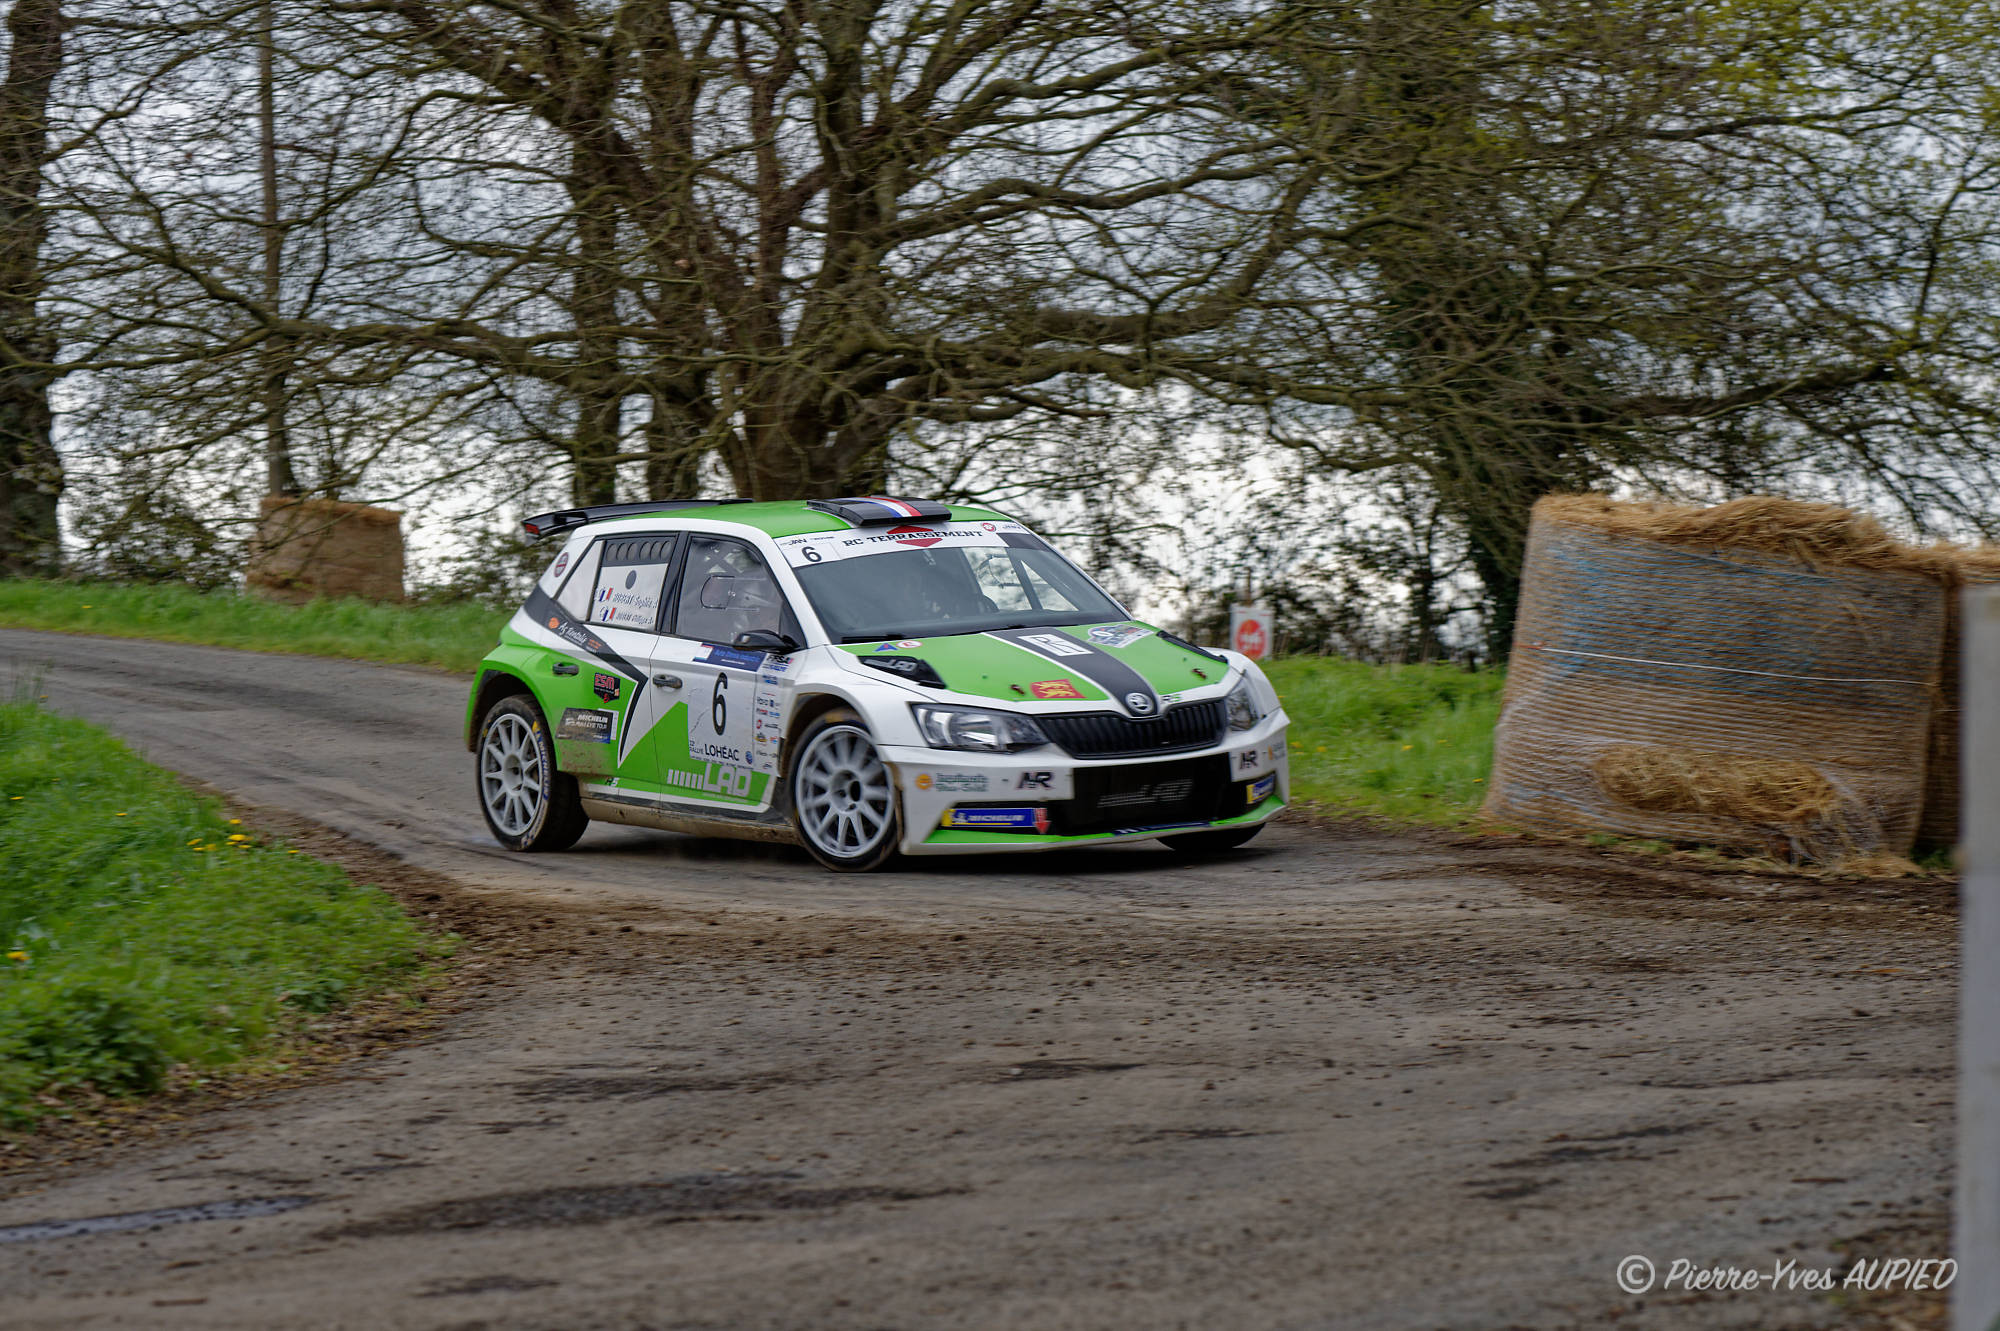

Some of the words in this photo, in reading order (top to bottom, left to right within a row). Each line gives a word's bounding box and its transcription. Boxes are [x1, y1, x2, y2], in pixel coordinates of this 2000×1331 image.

[842, 538, 864, 546] RC
[866, 530, 983, 543] TERRASSEMENT
[801, 546, 822, 562] 6
[594, 673, 615, 690] ESM
[712, 672, 728, 736] 6
[577, 714, 609, 724] MICHELIN
[704, 743, 740, 762] LOHÉAC
[703, 762, 753, 797] LAD
